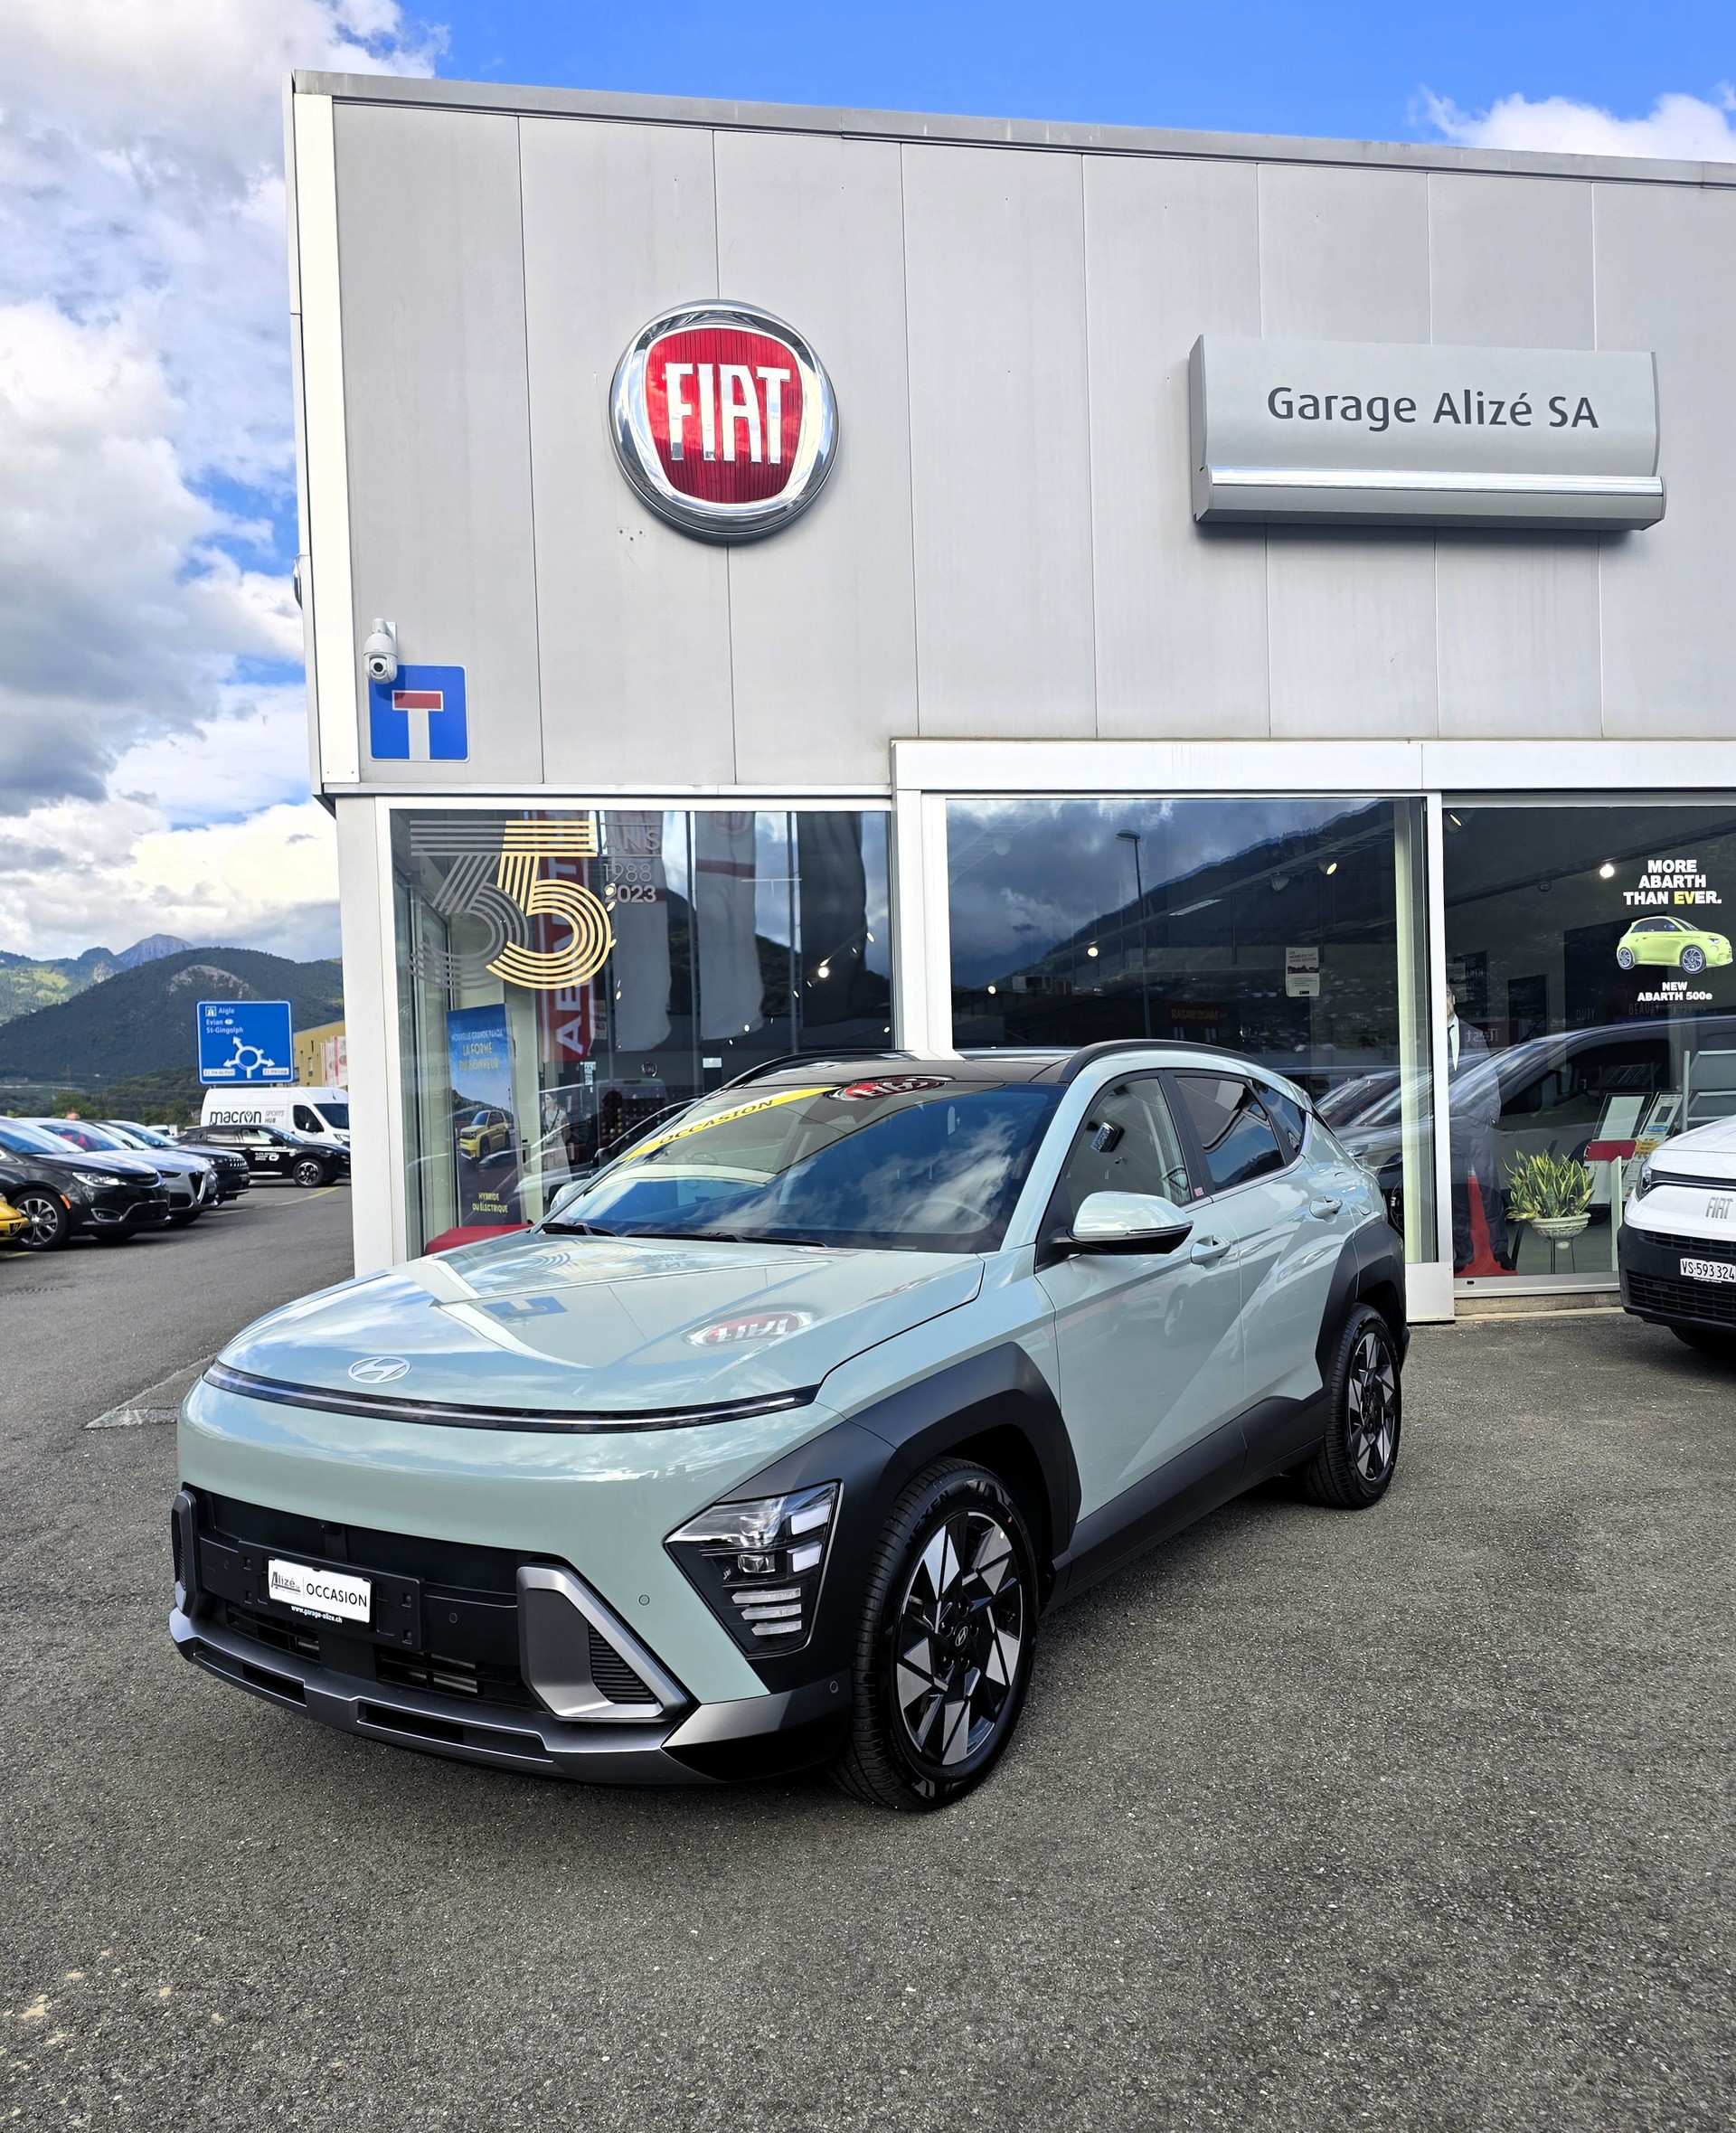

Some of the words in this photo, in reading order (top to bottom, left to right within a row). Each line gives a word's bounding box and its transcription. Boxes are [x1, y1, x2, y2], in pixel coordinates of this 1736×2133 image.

[664, 363, 791, 465] FIAT
[1267, 386, 1417, 433] Garage
[1432, 388, 1533, 428] Alizé
[1548, 395, 1599, 429] SA
[602, 828, 661, 852] ANS
[603, 863, 652, 883] 1988
[1647, 859, 1698, 874] MORE
[1638, 873, 1707, 889] ABARTH
[605, 883, 656, 904] 2023
[1623, 891, 1669, 906] THAN
[1674, 890, 1722, 905] EVER.
[409, 819, 612, 990] 35
[1662, 982, 1688, 991] NEW
[1637, 992, 1684, 1002] ABARTH
[1685, 991, 1712, 1001] 500e
[218, 1007, 235, 1015] Aigle
[206, 1026, 244, 1035] St-Gingolph
[462, 1044, 470, 1056] LA
[470, 1042, 493, 1055] FORME
[459, 1060, 467, 1071] DU
[468, 1057, 499, 1071] BONHEUR
[209, 1110, 262, 1126] macron
[659, 1100, 773, 1144] OCCASION
[478, 1192, 500, 1202] HYBRIDE
[472, 1203, 479, 1212] OU
[479, 1202, 508, 1213] ÉLECTRIQUE
[1705, 1196, 1734, 1220] FIAT
[904, 1489, 950, 1551] NEXEN
[271, 1571, 296, 1589] Alizé
[306, 1582, 367, 1608] OCCASION
